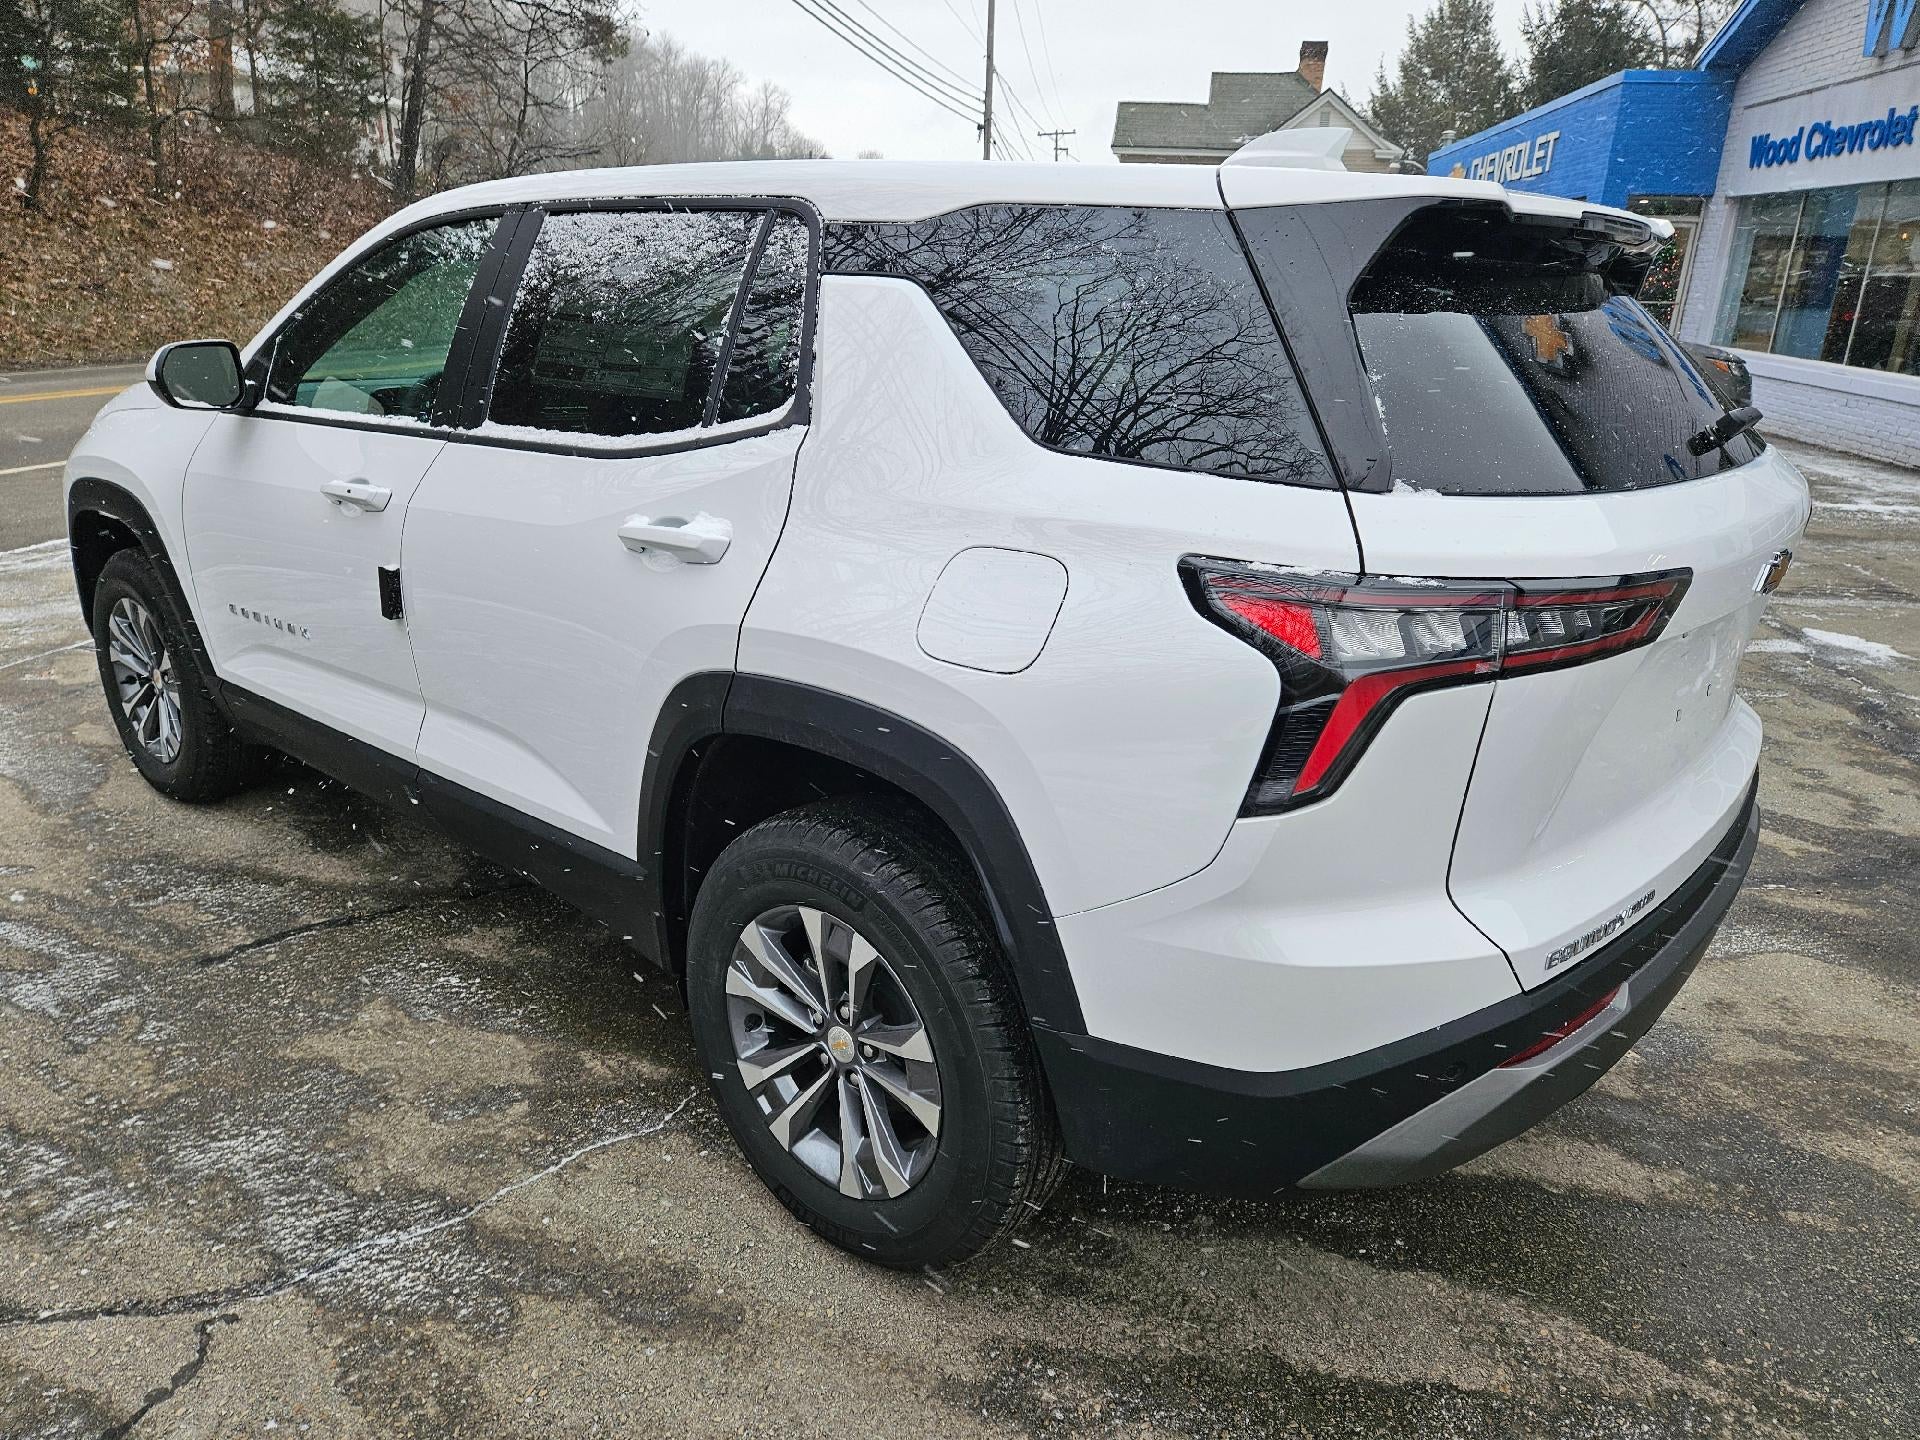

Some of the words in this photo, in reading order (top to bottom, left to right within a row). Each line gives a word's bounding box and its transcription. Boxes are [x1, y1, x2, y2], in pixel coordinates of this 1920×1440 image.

[1470, 130, 1561, 184] CHEVROLET
[1749, 126, 1805, 170] Wood
[1805, 104, 1919, 162] Chevrolet
[772, 862, 866, 910] MICHELIN
[1544, 910, 1627, 970] EQUINOX
